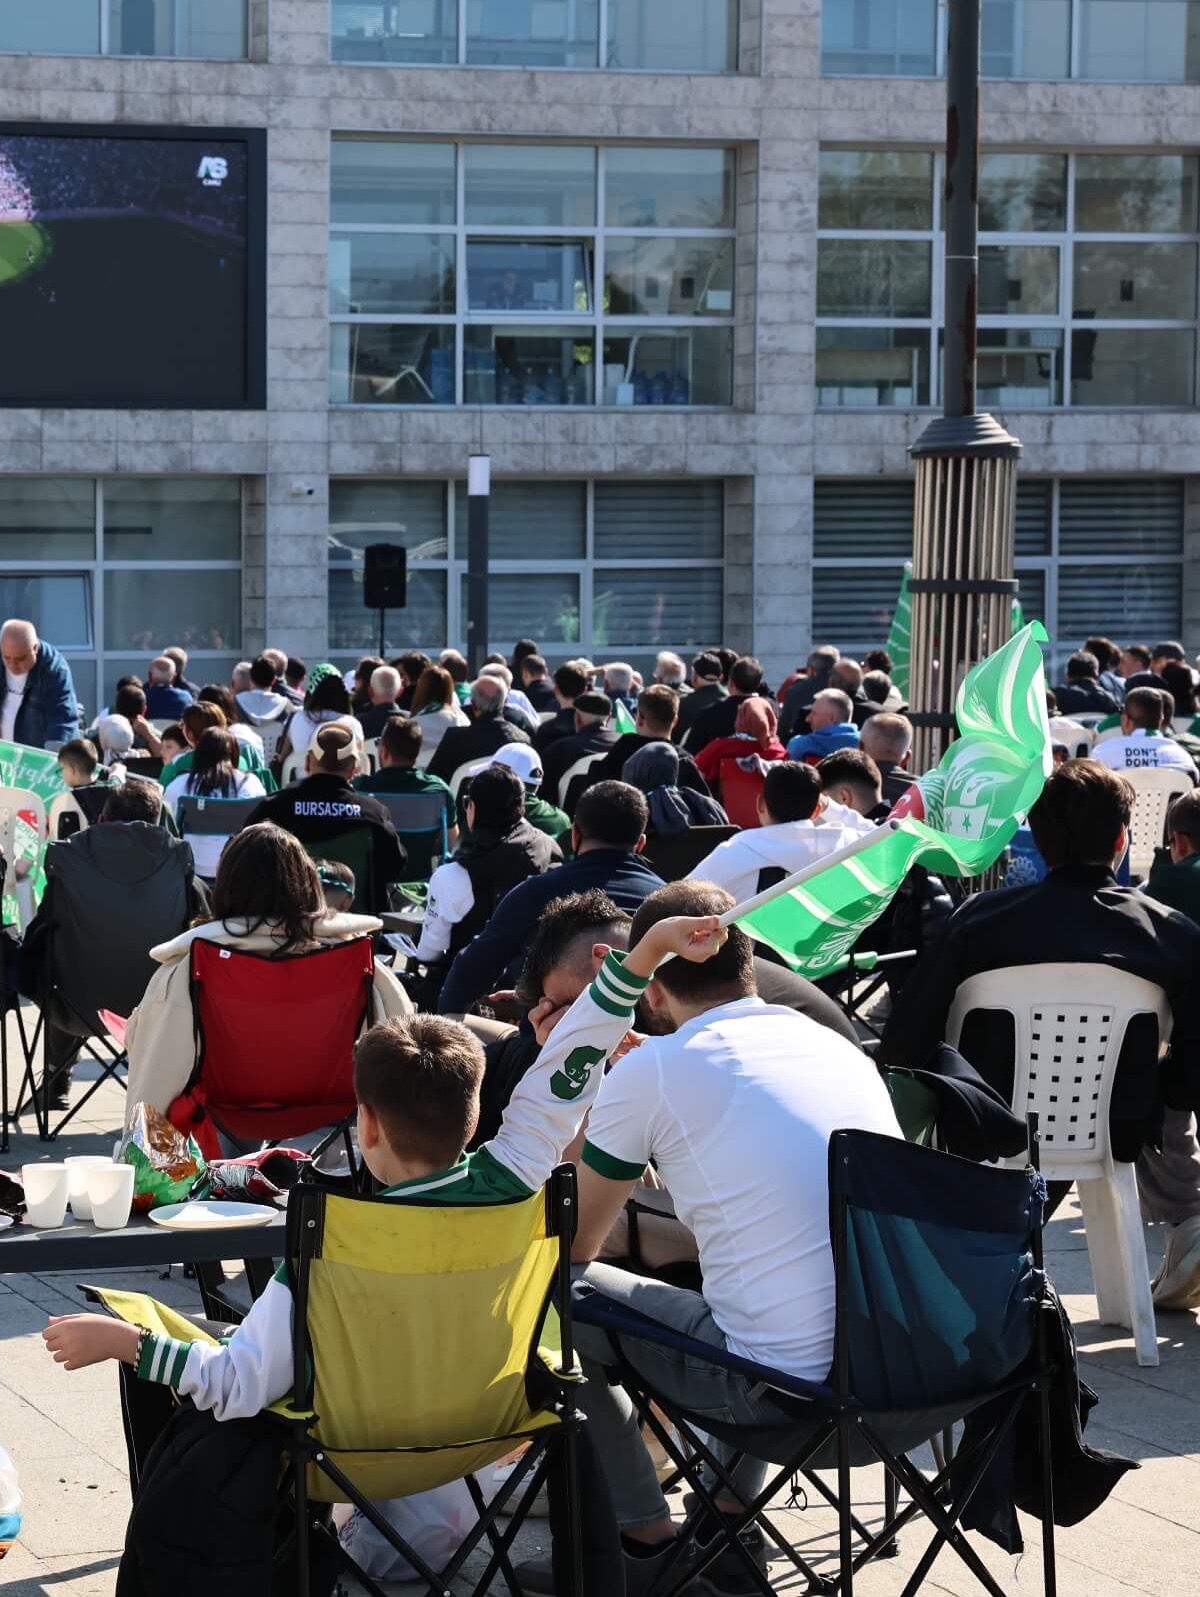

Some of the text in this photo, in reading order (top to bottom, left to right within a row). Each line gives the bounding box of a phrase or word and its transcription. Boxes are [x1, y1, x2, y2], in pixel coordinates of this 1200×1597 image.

[1125, 747, 1157, 757] DON'T
[1125, 758, 1159, 768] DON'T
[294, 801, 361, 816] BURSASPOR
